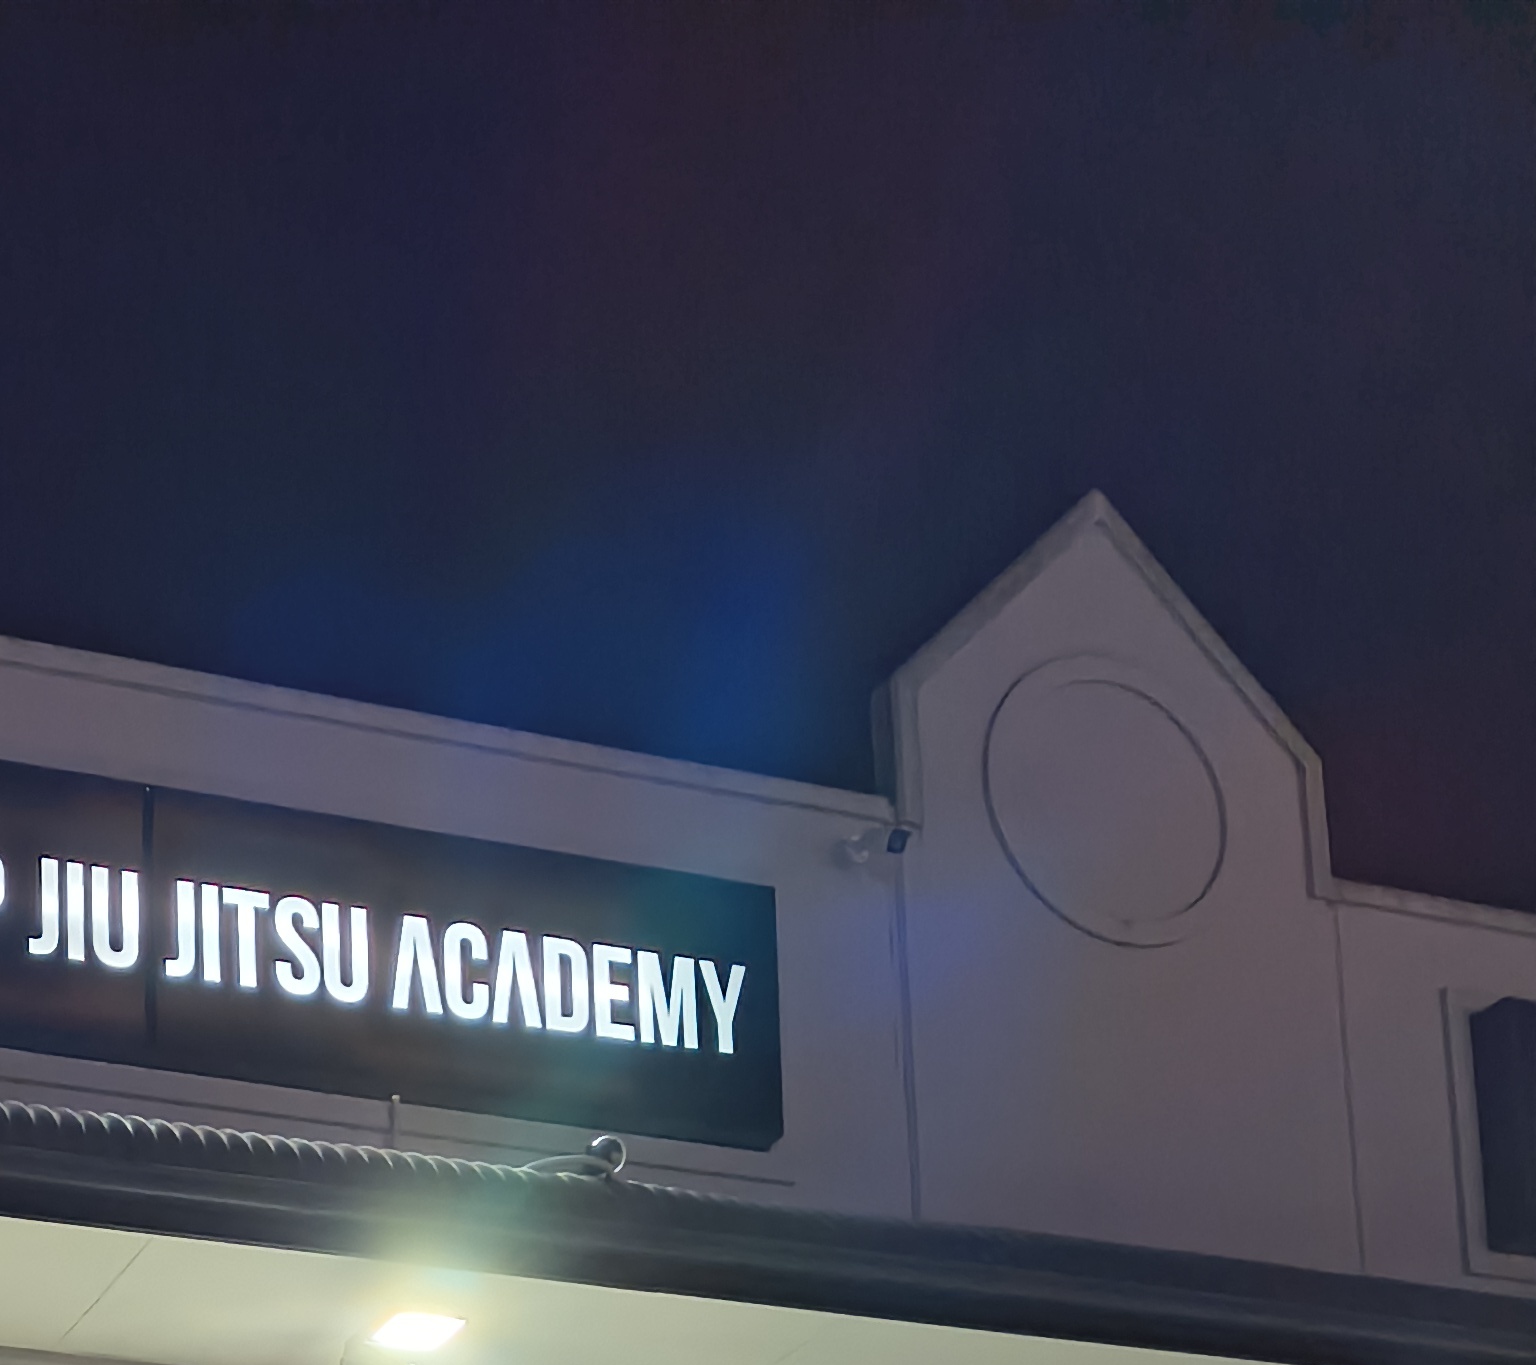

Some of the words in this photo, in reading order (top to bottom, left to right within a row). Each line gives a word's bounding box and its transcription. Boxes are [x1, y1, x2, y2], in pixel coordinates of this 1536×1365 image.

[27, 856, 141, 970] JIU
[163, 879, 370, 1004] JITSU
[390, 914, 747, 1054] ACADEMY
